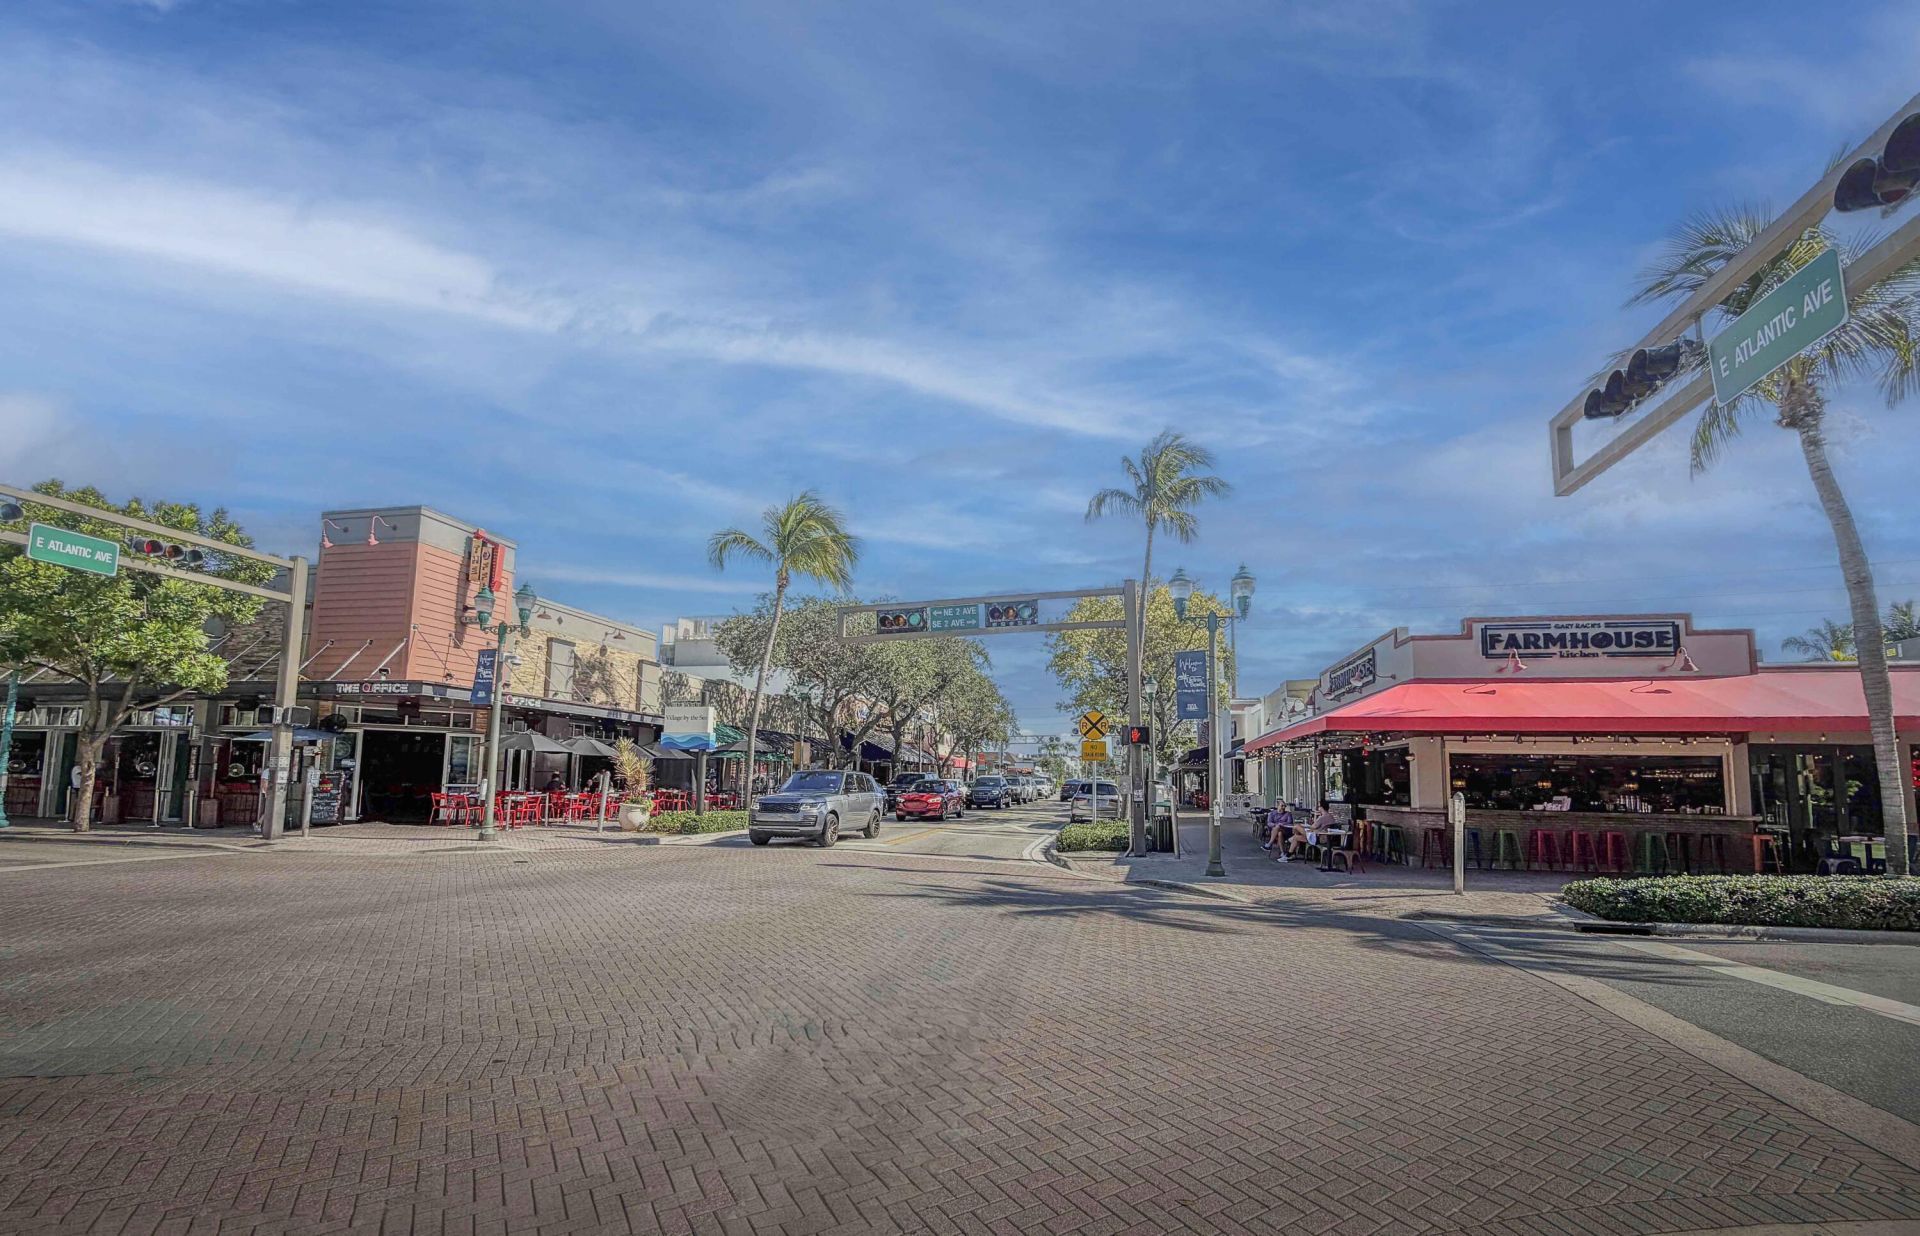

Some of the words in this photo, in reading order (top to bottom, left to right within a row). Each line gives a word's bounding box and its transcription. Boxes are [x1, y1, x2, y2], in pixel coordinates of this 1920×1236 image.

[1719, 356, 1730, 378] E
[1735, 306, 1797, 368] ATLANTIC
[1802, 278, 1833, 319] AVE
[36, 536, 45, 548] E
[47, 540, 92, 559] ATLANTIC
[94, 550, 113, 563] AVE
[943, 607, 954, 617] NE
[955, 606, 961, 616] 2
[962, 606, 977, 615] AVE
[932, 620, 942, 629] SE
[944, 619, 950, 628] 2
[950, 618, 965, 628] AVE
[1488, 630, 1673, 650] FARMHOUSE
[1558, 650, 1600, 658] kitchen
[336, 683, 360, 693] THE
[362, 682, 409, 693] OFFICE
[1082, 721, 1088, 730] R
[1100, 721, 1107, 730] R
